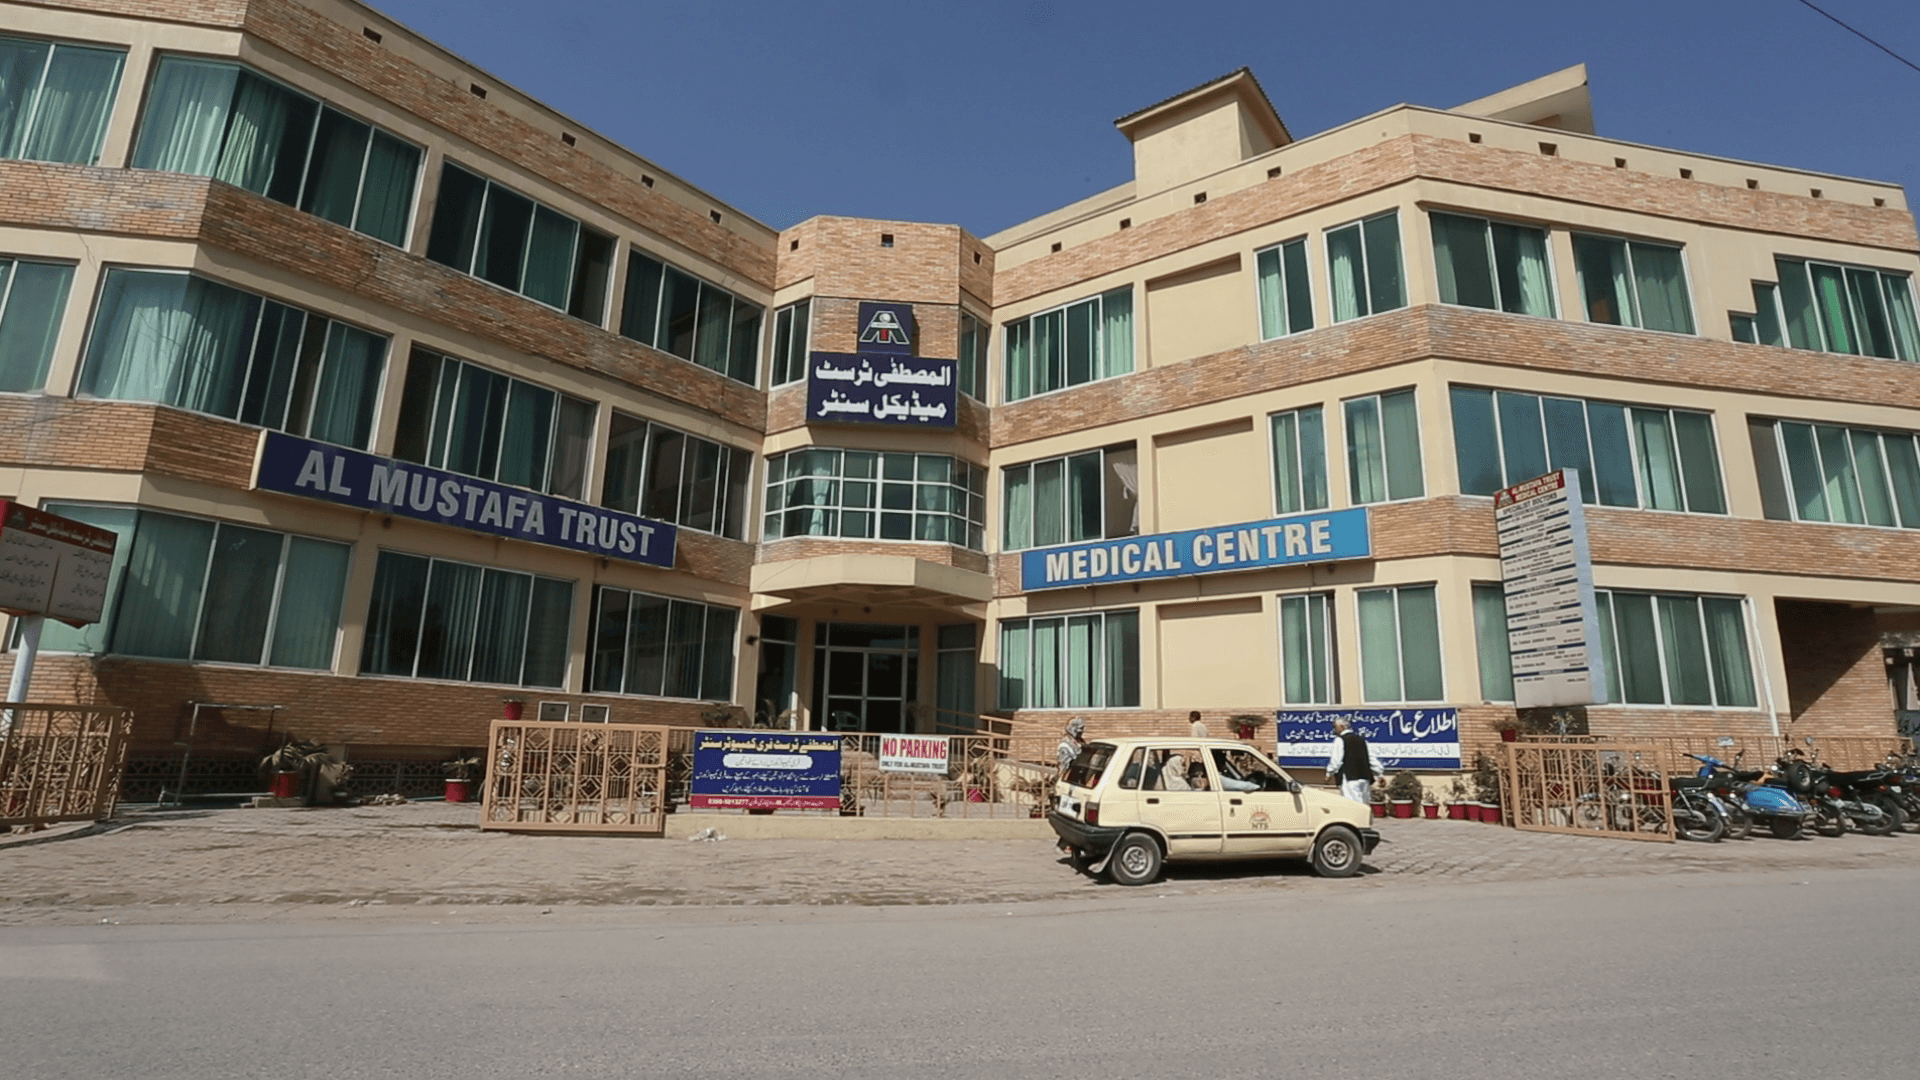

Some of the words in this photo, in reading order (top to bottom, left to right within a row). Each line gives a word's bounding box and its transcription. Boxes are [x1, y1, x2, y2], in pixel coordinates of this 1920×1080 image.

[815, 358, 873, 387] ٹرسٹ
[816, 389, 870, 417] سنٹر
[873, 390, 947, 422] میڈیکل
[295, 450, 352, 496] AL
[367, 464, 545, 536] MUSTAFA
[558, 507, 655, 557] TRUST
[1045, 539, 1182, 583] MEDICAL
[1192, 519, 1332, 567] CENTRE
[1389, 710, 1412, 737] عام
[883, 737, 898, 757] NO
[900, 738, 947, 759] PARKING
